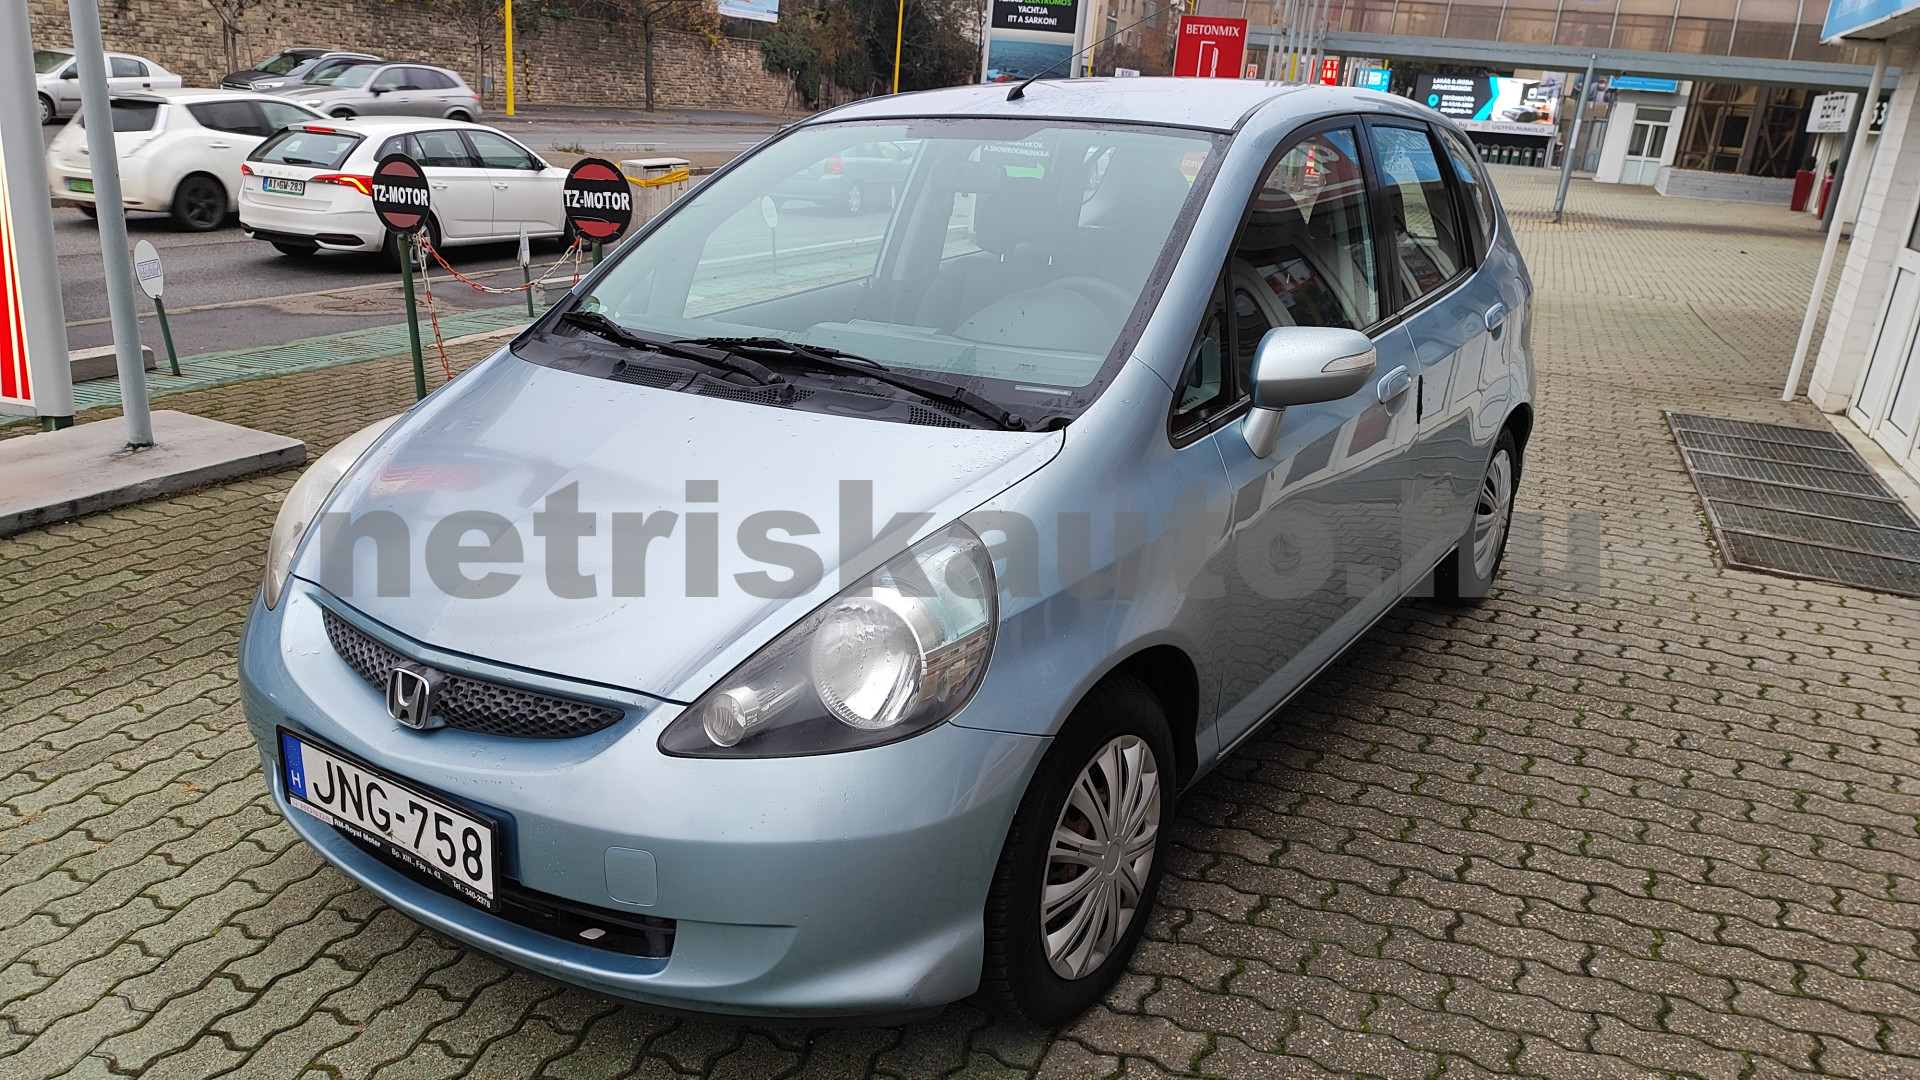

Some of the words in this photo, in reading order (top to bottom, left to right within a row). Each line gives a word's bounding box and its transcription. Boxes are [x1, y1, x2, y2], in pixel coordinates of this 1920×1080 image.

[1017, 5, 1048, 14] YACHTJA
[1007, 15, 1017, 23] ITT
[1018, 15, 1024, 23] A
[1024, 16, 1058, 25] SARKON!
[1185, 23, 1240, 37] BETONMIX
[372, 184, 429, 207] TZ-MOTOR
[564, 189, 631, 211] TZ-MOTOR
[290, 769, 302, 789] H
[312, 760, 484, 882] JNG-758
[363, 832, 381, 848] Motor
